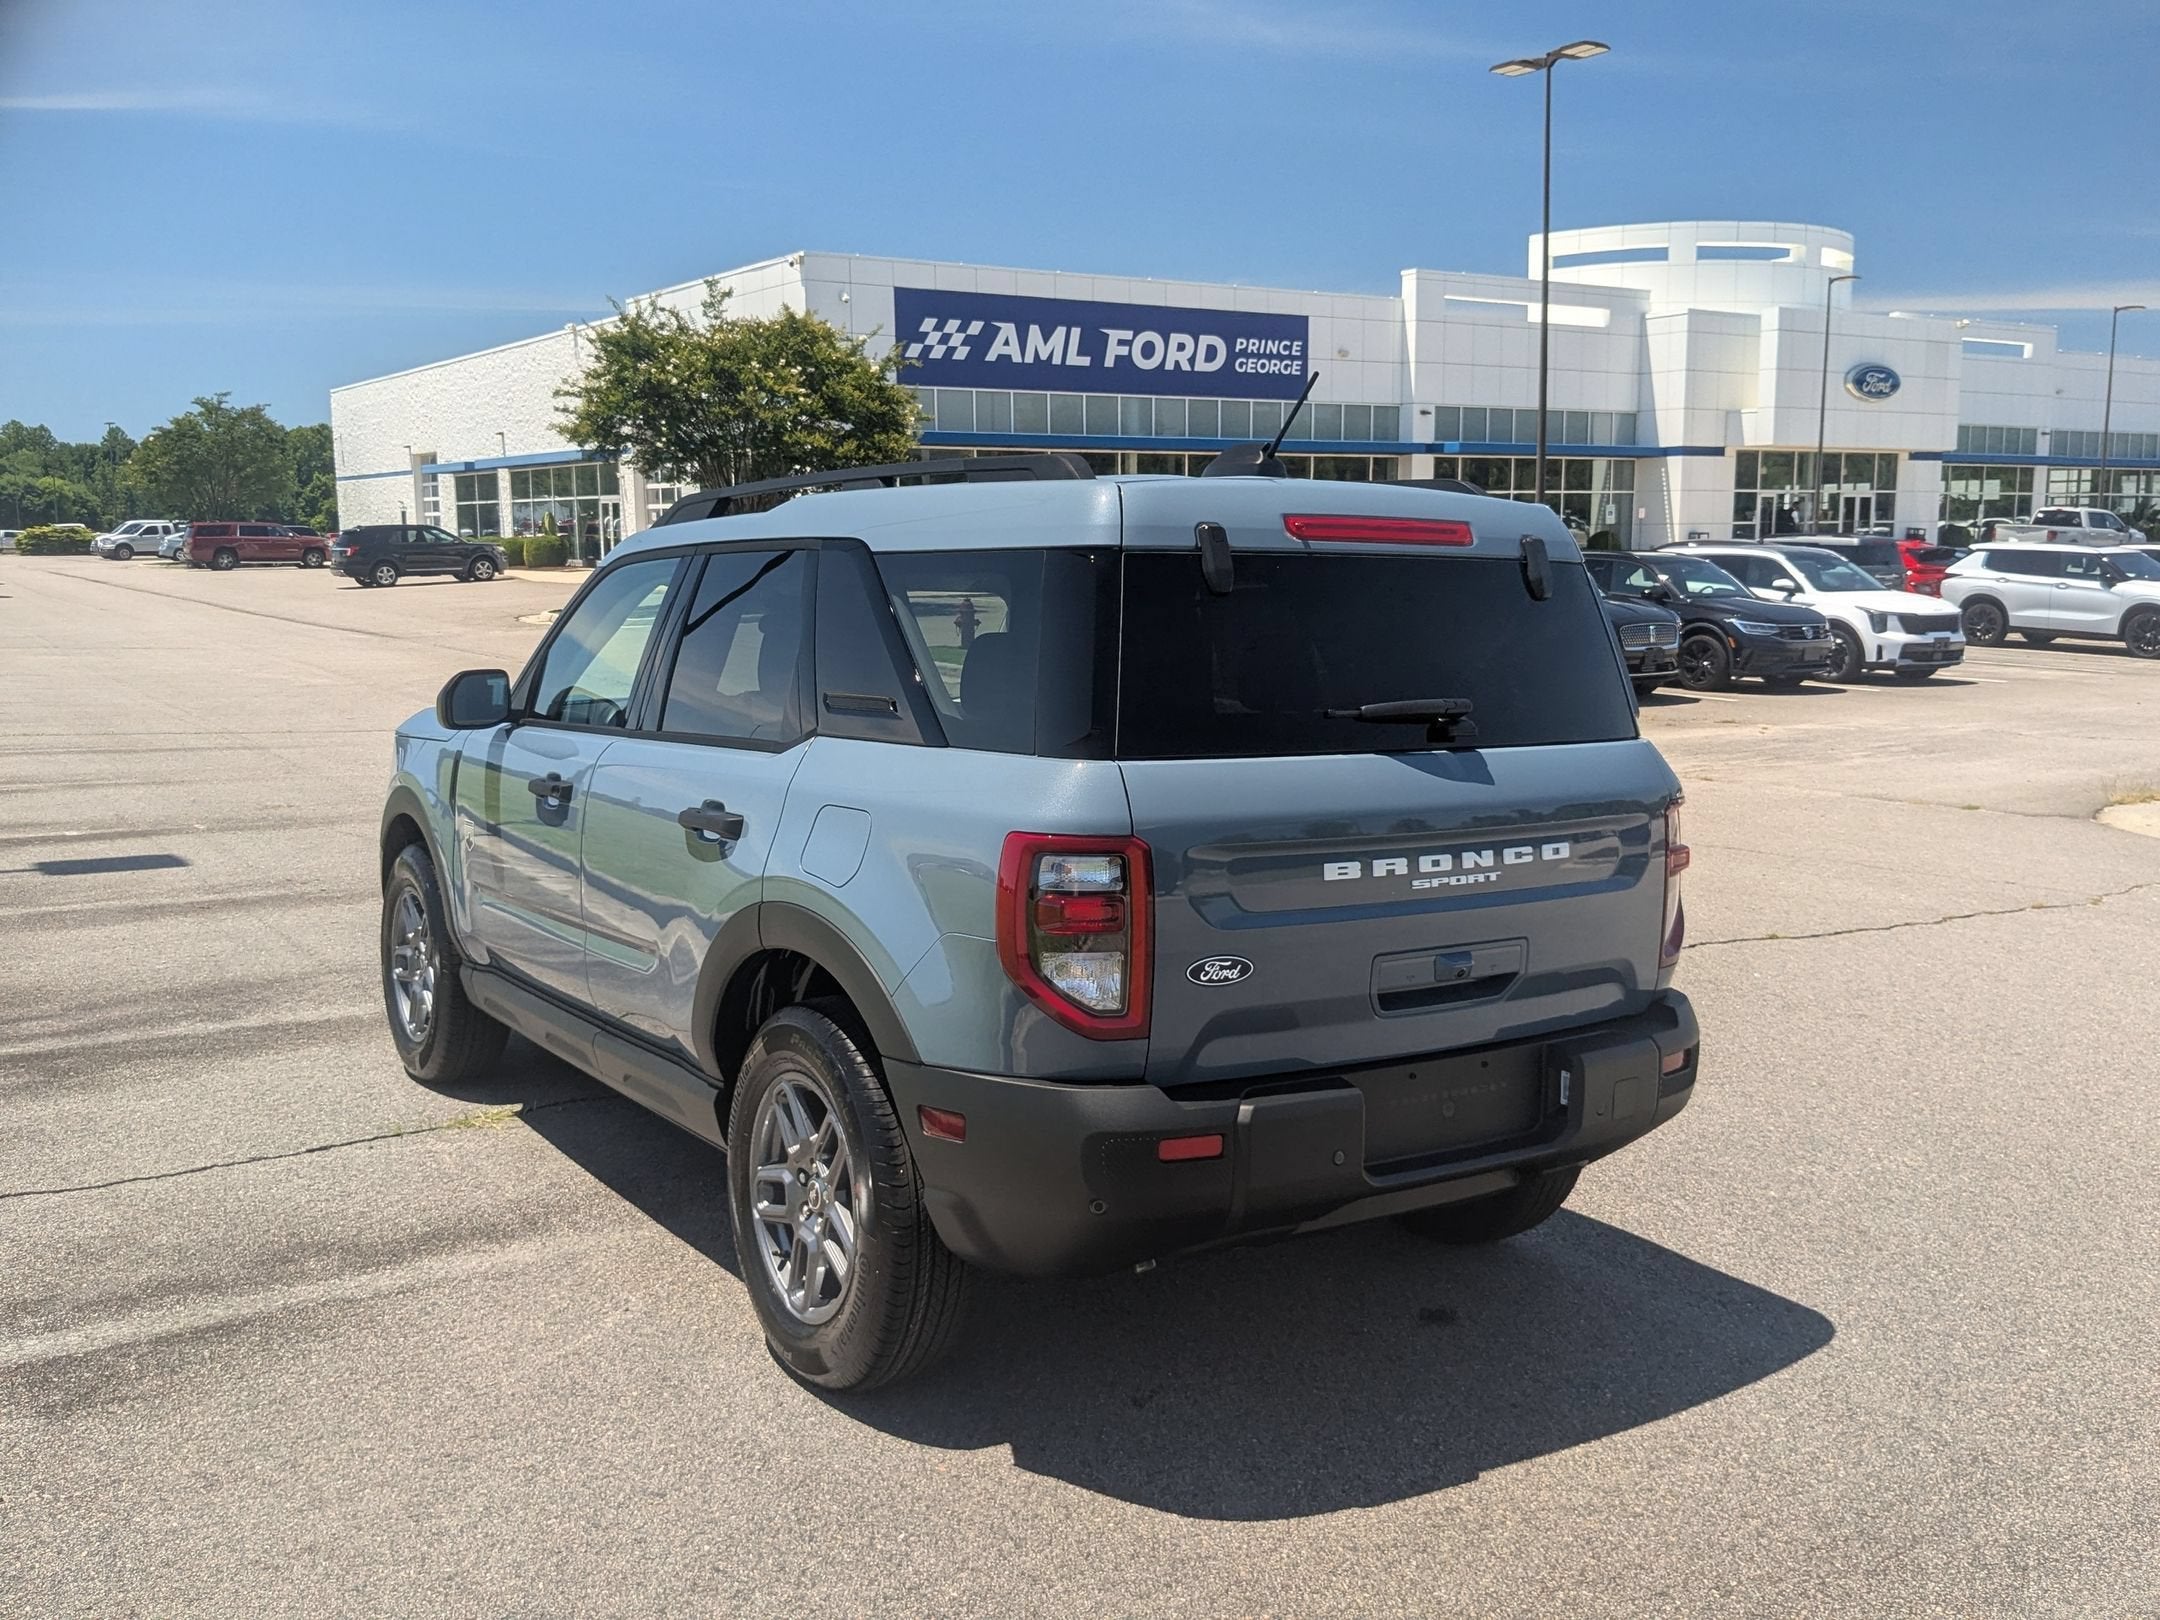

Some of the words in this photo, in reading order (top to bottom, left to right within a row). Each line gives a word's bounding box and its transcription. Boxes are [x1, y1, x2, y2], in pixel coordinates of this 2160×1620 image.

[984, 321, 1091, 367] AML
[1099, 328, 1227, 373] FORD
[1235, 337, 1303, 356] PRINCE
[1234, 357, 1302, 376] GEORGE
[1862, 371, 1893, 393] Ford
[1323, 841, 1571, 882] BRONCO
[1411, 871, 1502, 890] SPORT
[1199, 960, 1243, 982] Ford
